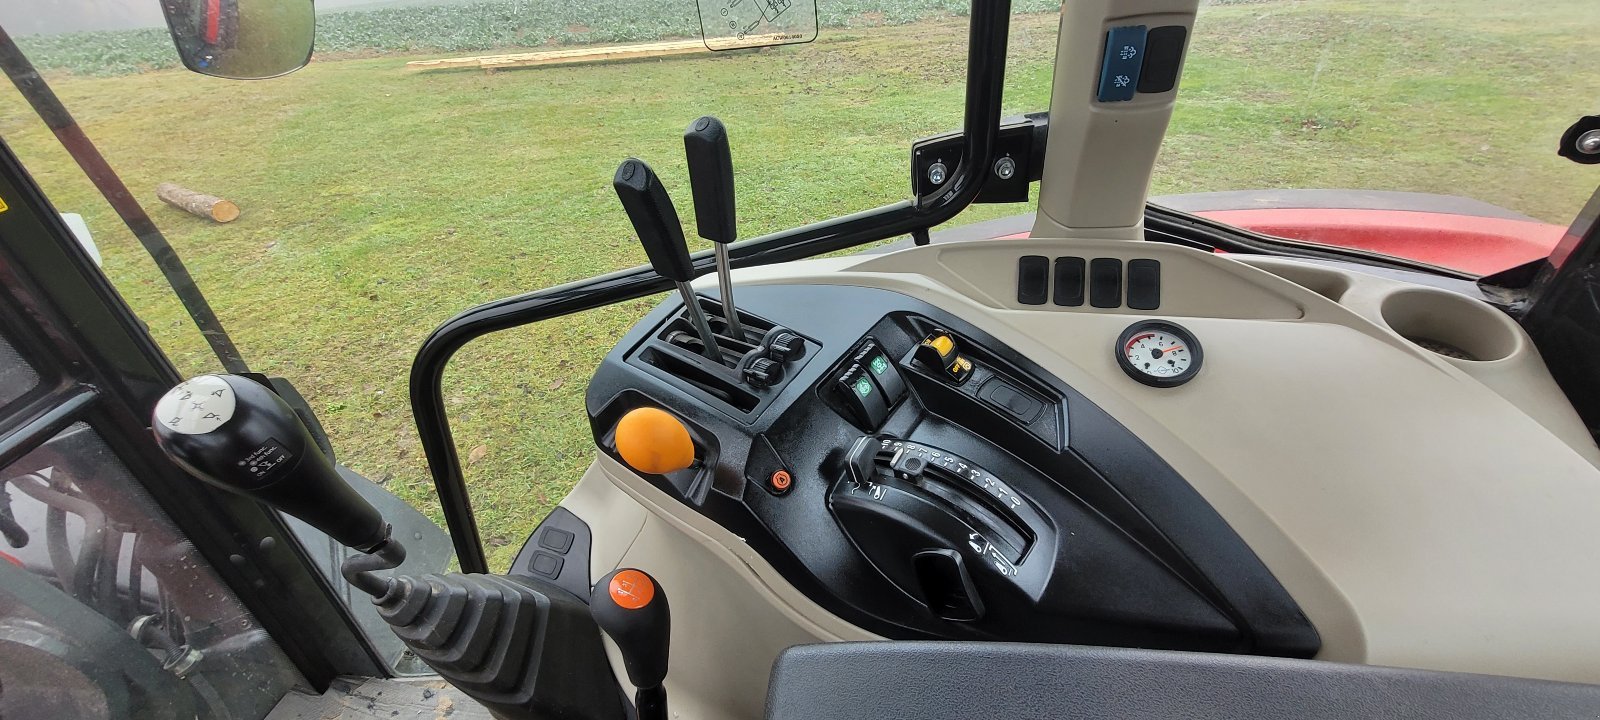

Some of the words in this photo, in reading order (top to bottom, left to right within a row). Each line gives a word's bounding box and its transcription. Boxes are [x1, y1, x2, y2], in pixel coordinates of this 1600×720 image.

[882, 440, 891, 448] 10
[276, 454, 285, 463] OFF
[971, 469, 980, 477] 3
[985, 477, 995, 486] 2
[998, 487, 1008, 495] 1
[1011, 496, 1021, 506] 0
